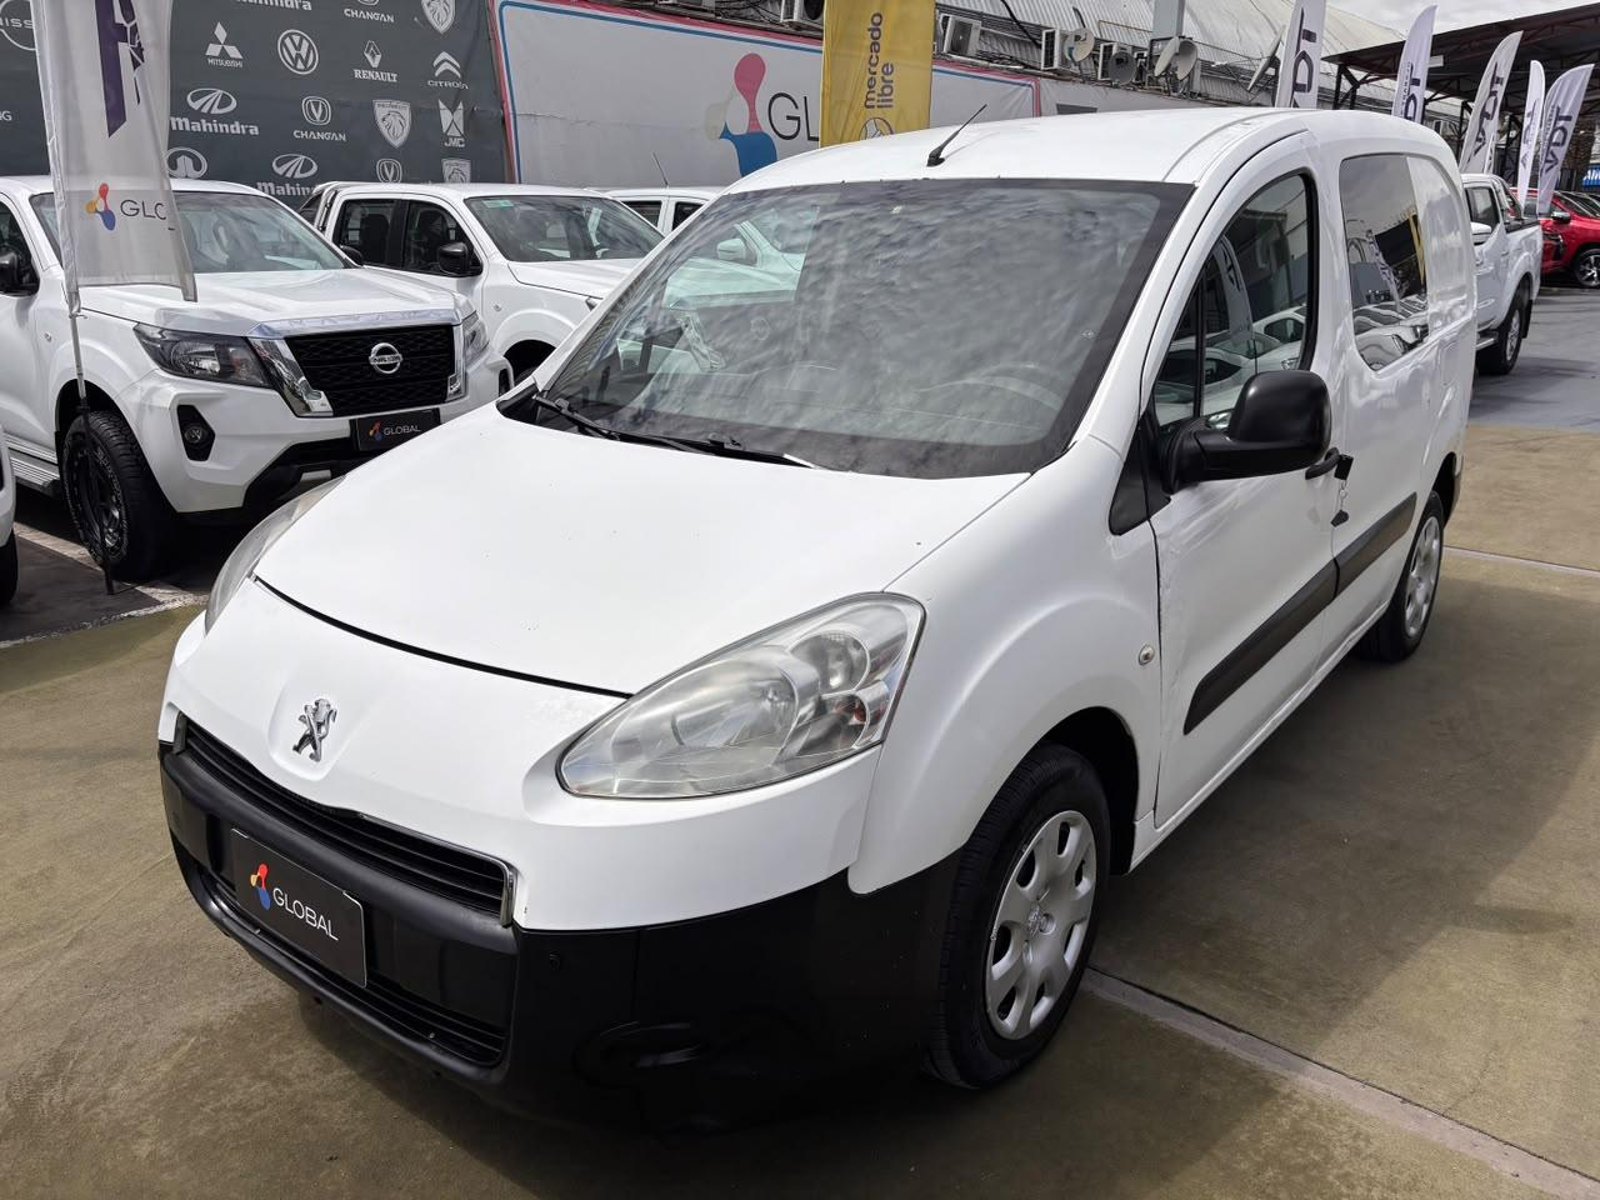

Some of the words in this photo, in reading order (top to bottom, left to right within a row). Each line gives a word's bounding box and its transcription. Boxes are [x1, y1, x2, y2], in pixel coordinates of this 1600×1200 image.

[344, 8, 395, 23] CHANGAN
[864, 12, 883, 109] mercado
[1290, 7, 1317, 108] DT
[354, 69, 398, 83] RENAULT
[877, 62, 894, 109] libre
[170, 115, 260, 136] Mahindra
[293, 130, 347, 142] CHANGAN
[444, 137, 465, 148] JMC
[384, 425, 421, 436] GLOBAL
[273, 887, 339, 942] GLOBAL
